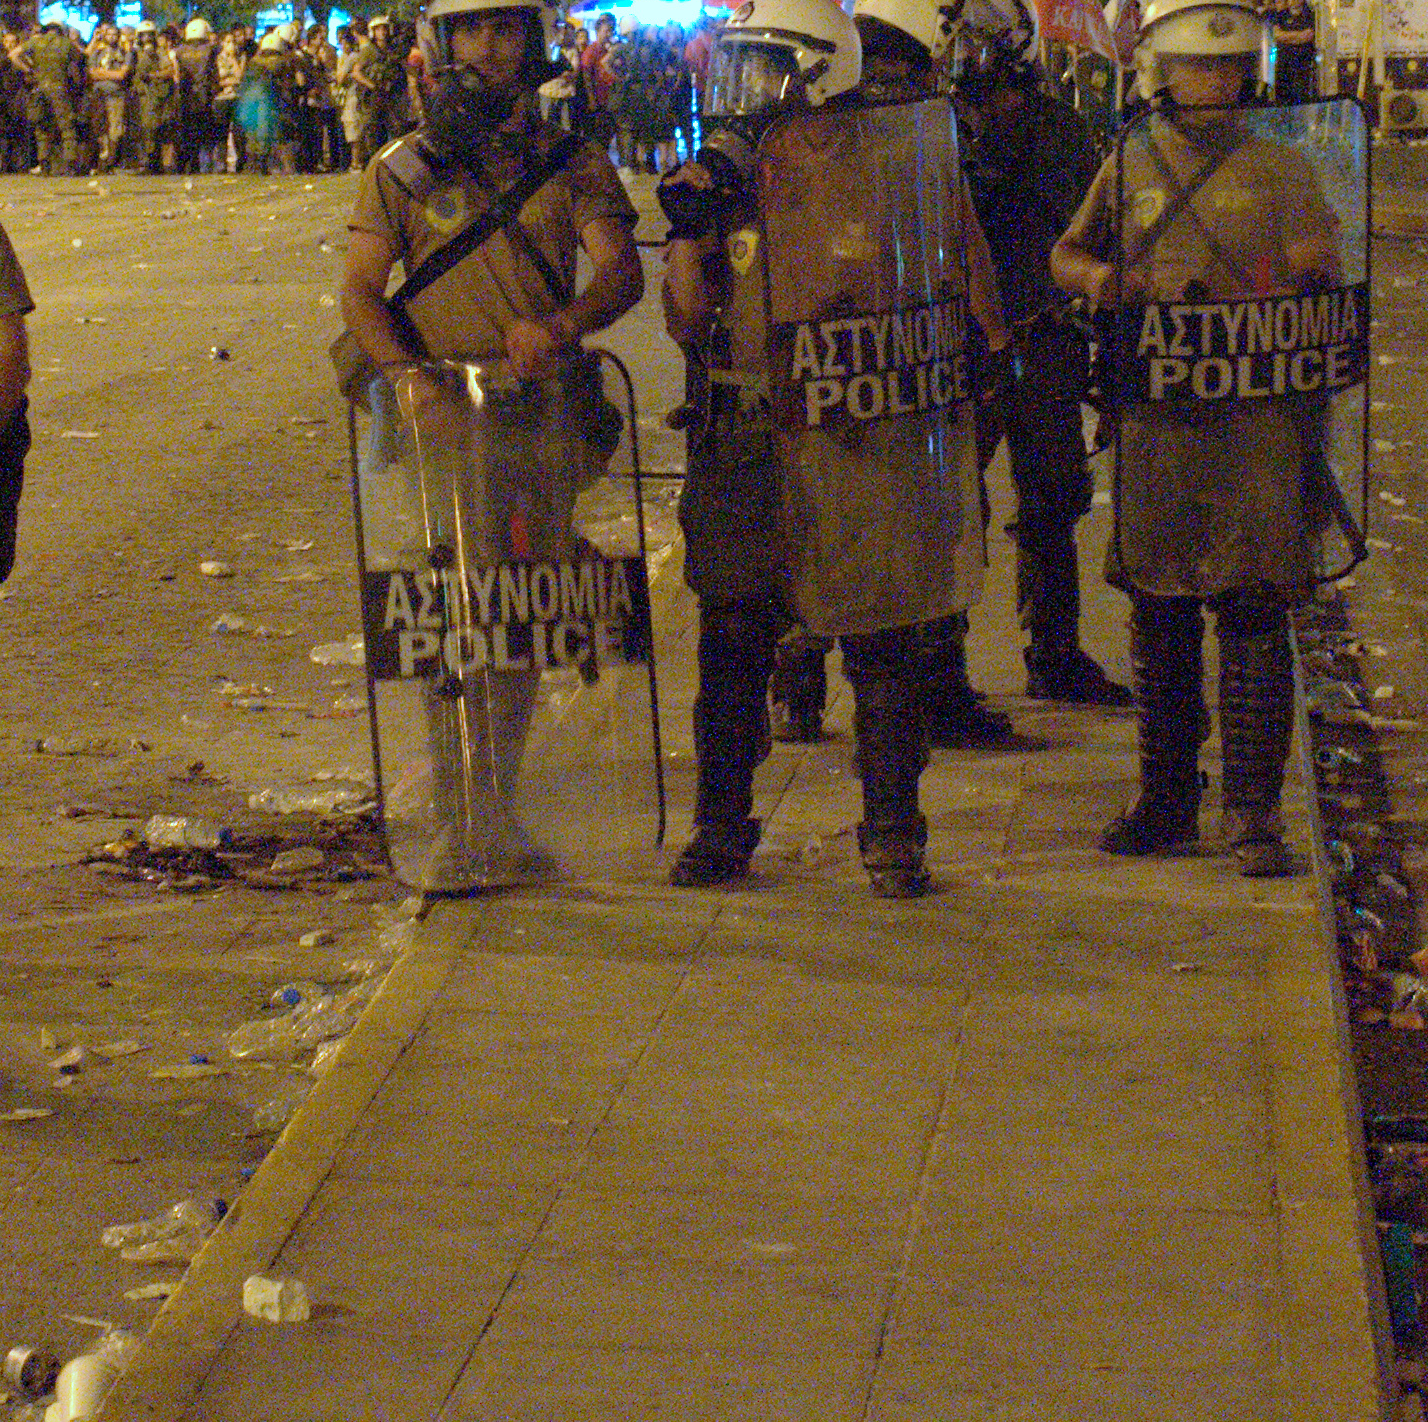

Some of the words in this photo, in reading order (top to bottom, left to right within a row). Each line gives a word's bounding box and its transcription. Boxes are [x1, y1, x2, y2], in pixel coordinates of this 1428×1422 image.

[1136, 292, 1359, 357] ΑΣΤΥΝΟΜΙΑ
[804, 354, 969, 425] POLICE
[1148, 343, 1352, 400] POLICE
[384, 560, 632, 630] ΑΣΤΥΝΟΜΙΑ
[398, 622, 623, 679] POLICE
